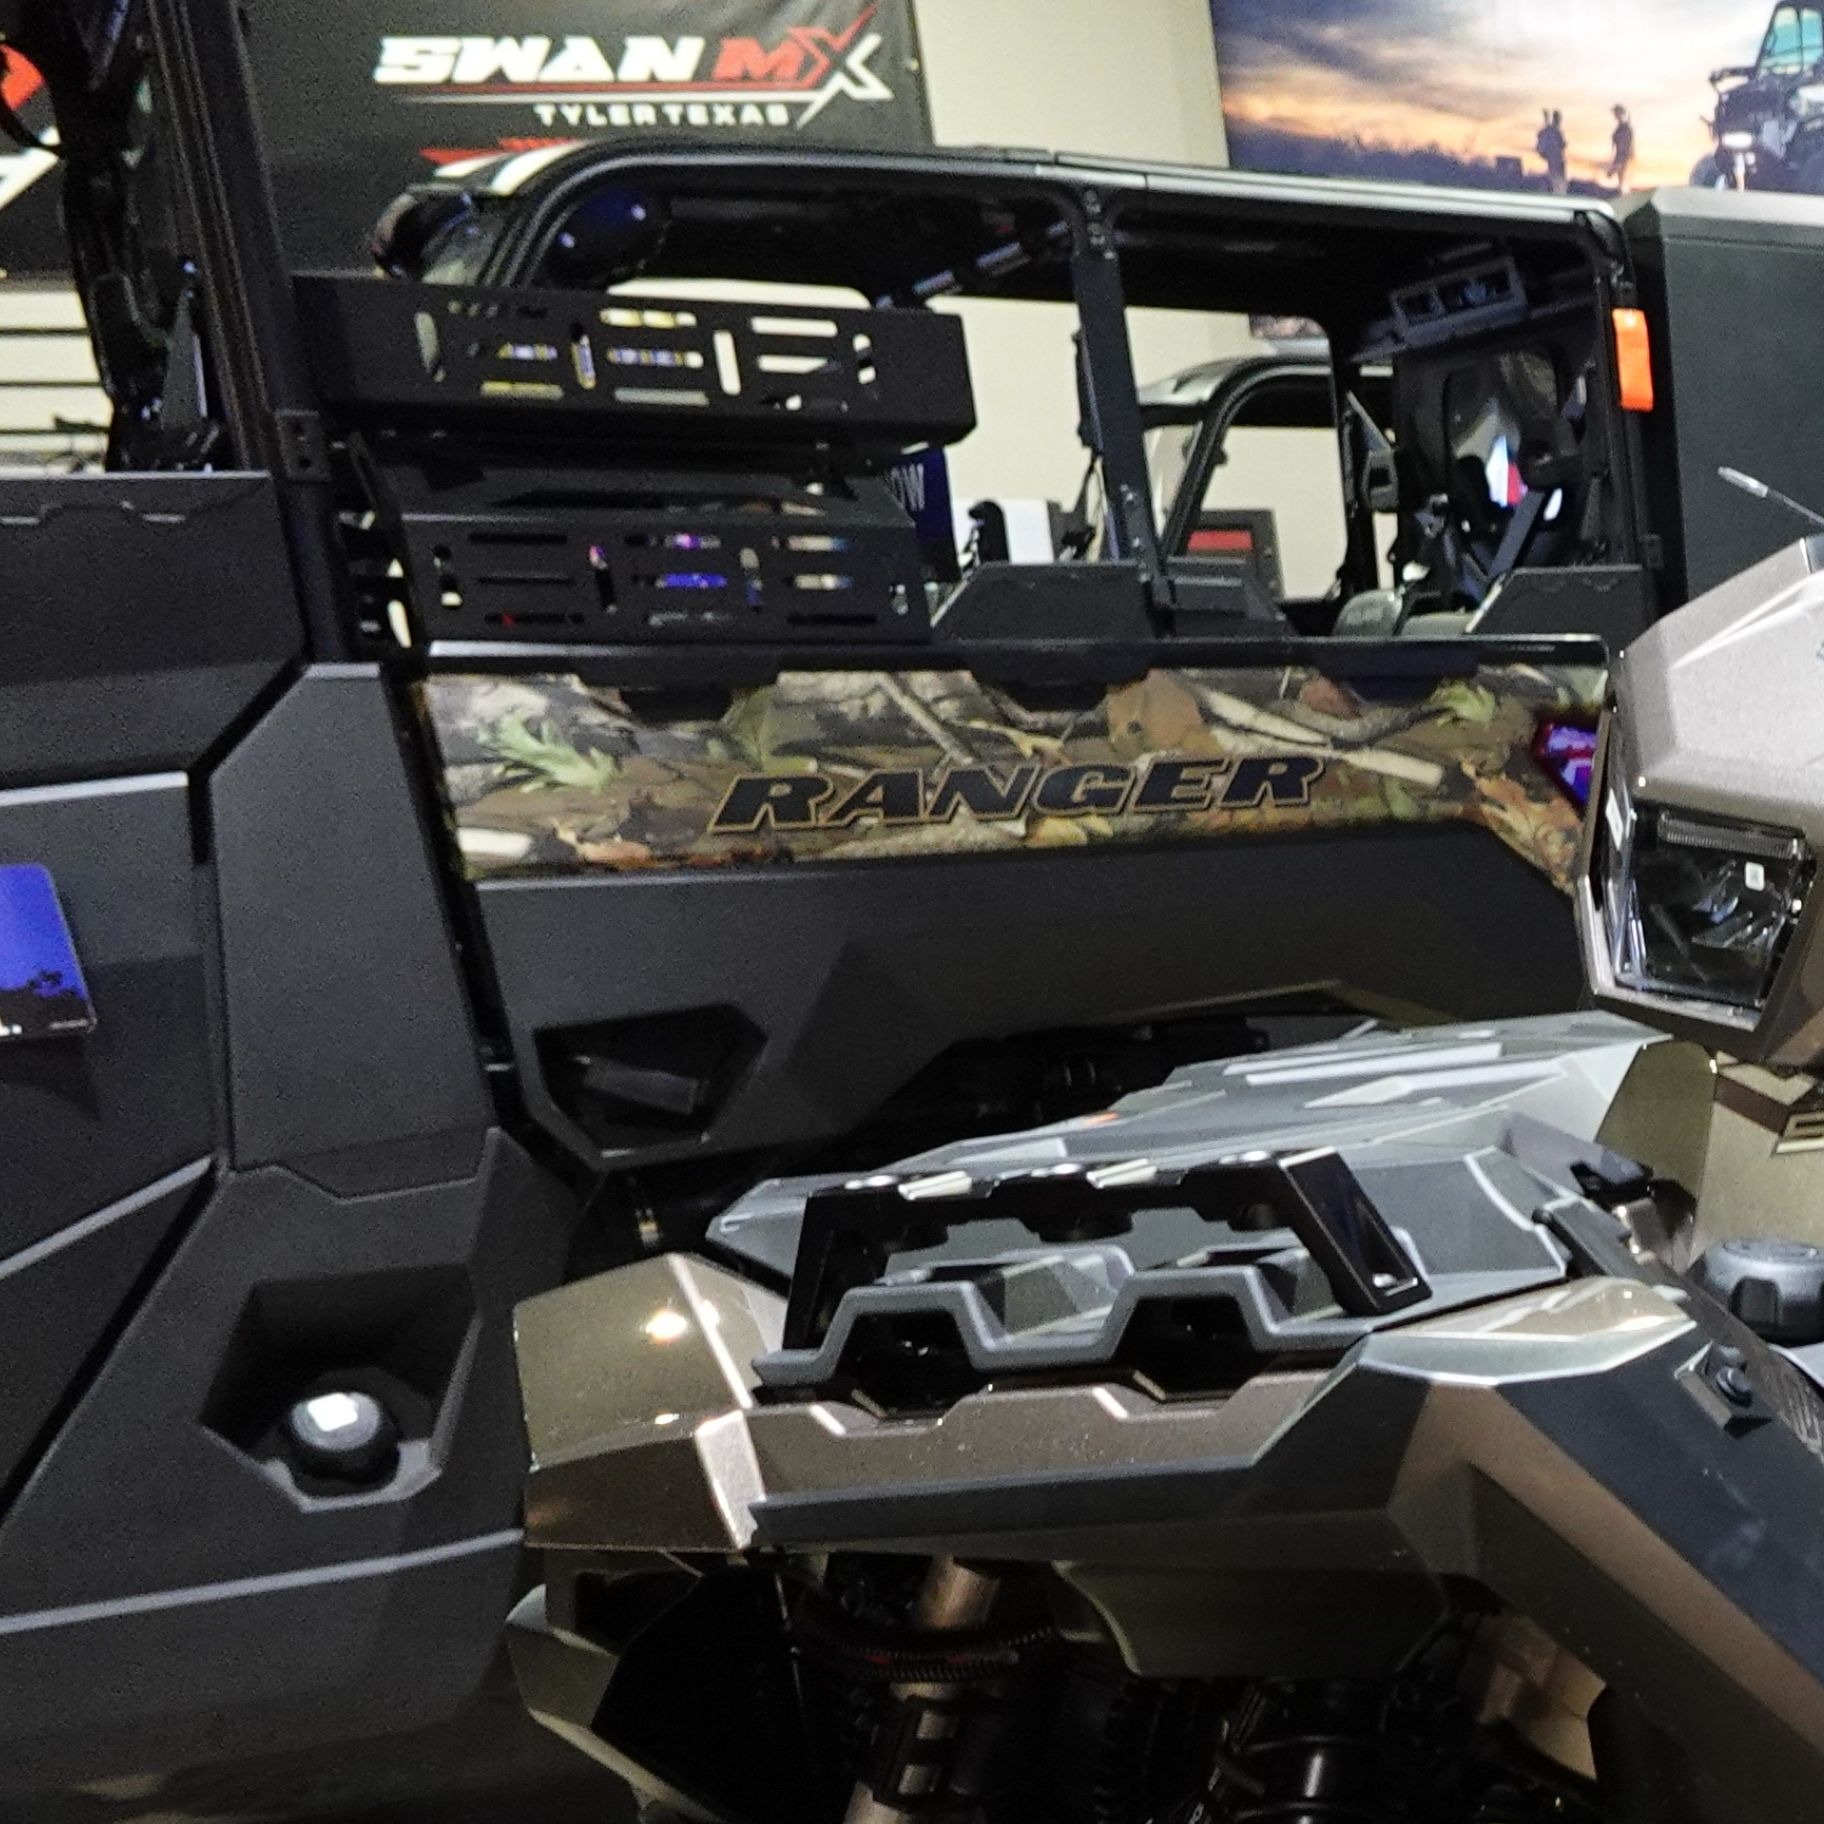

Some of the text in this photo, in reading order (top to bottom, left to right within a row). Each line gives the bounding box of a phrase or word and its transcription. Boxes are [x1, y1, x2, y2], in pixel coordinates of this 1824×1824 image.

[373, 3, 894, 130] SWAN MX
[534, 104, 790, 126] TYLER TEXAS
[707, 755, 1327, 835] RANGER
